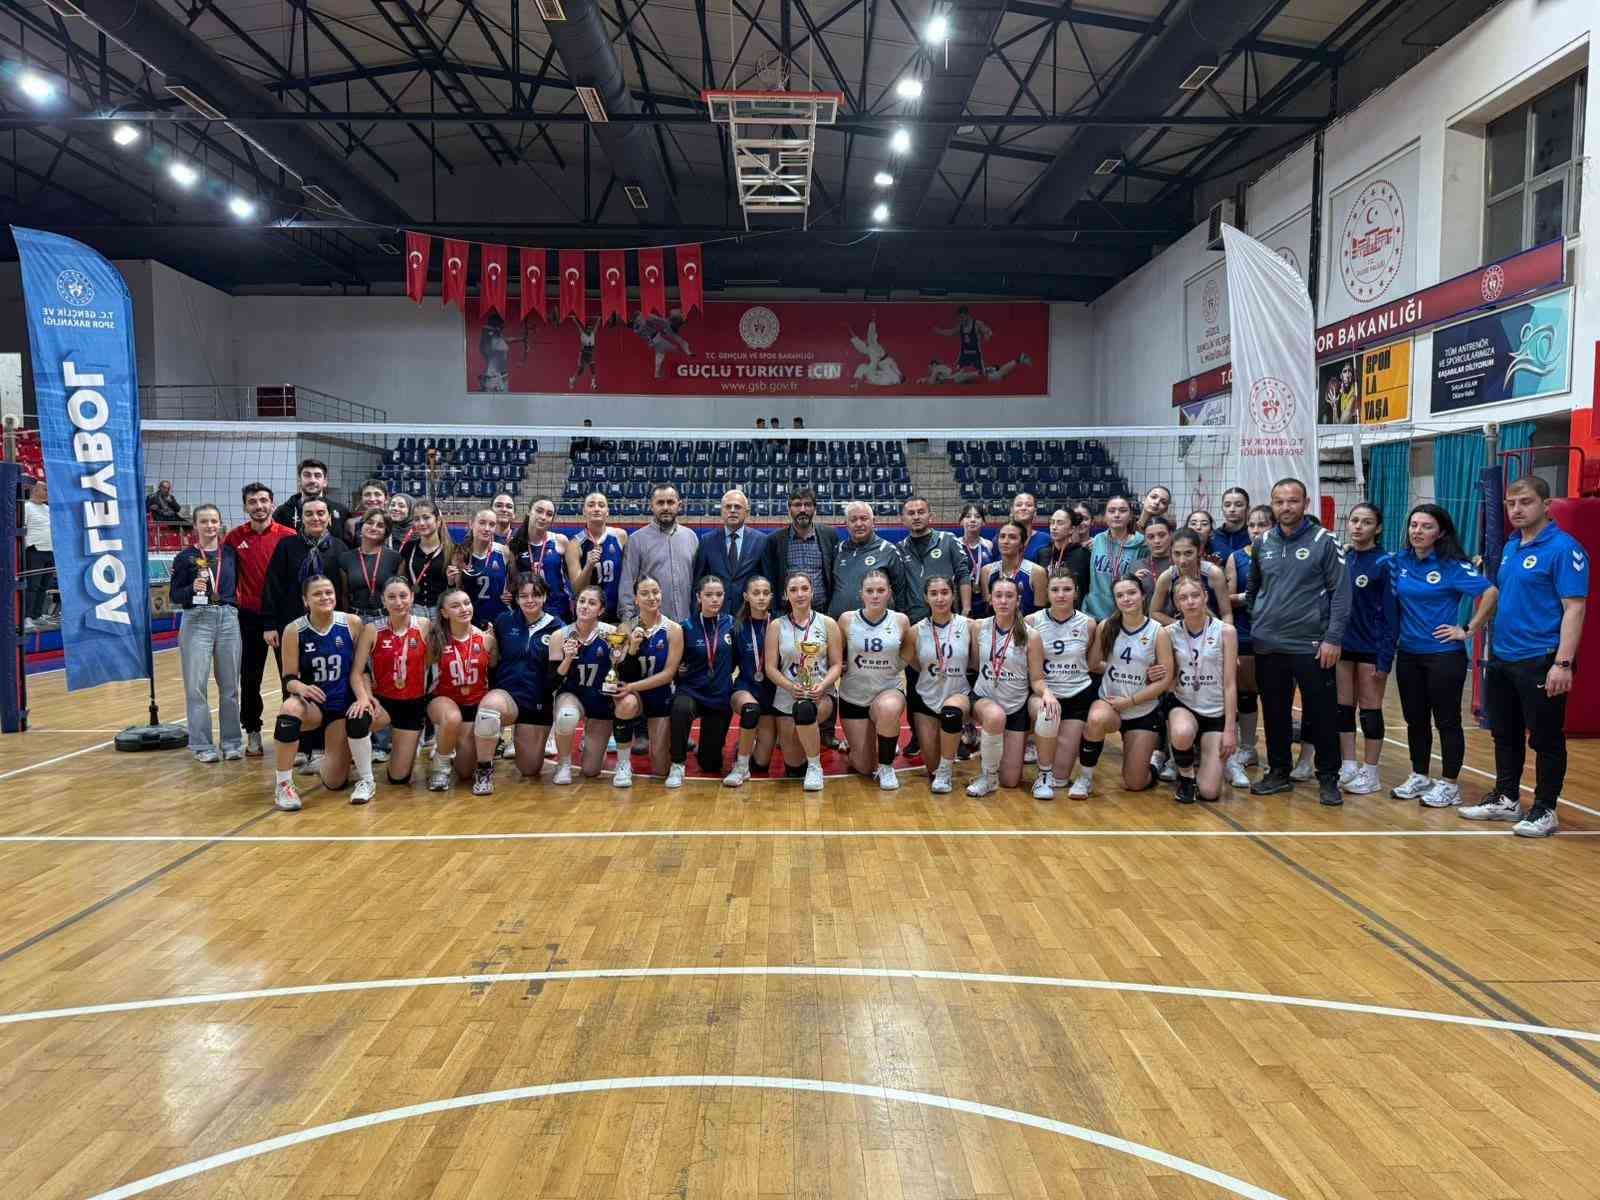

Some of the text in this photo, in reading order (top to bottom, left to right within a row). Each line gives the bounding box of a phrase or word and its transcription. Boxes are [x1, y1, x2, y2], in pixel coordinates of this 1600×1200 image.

[1314, 298, 1422, 353] OR BAKANLIĞI
[1366, 347, 1391, 375] SPOR
[1444, 346, 1457, 357] TÜM
[676, 362, 842, 379] GÜÇLÜ TÜRKİYE İÇİN
[720, 381, 798, 393] www.gsb.gov.tr
[1365, 375, 1377, 394] LA
[1364, 396, 1389, 421] YAŞA
[593, 559, 615, 584] 19
[476, 576, 491, 599] 2
[863, 637, 884, 653] 18
[1052, 639, 1066, 656] 9
[1119, 646, 1133, 665] 4
[311, 654, 343, 682] 33
[576, 663, 599, 687] 17
